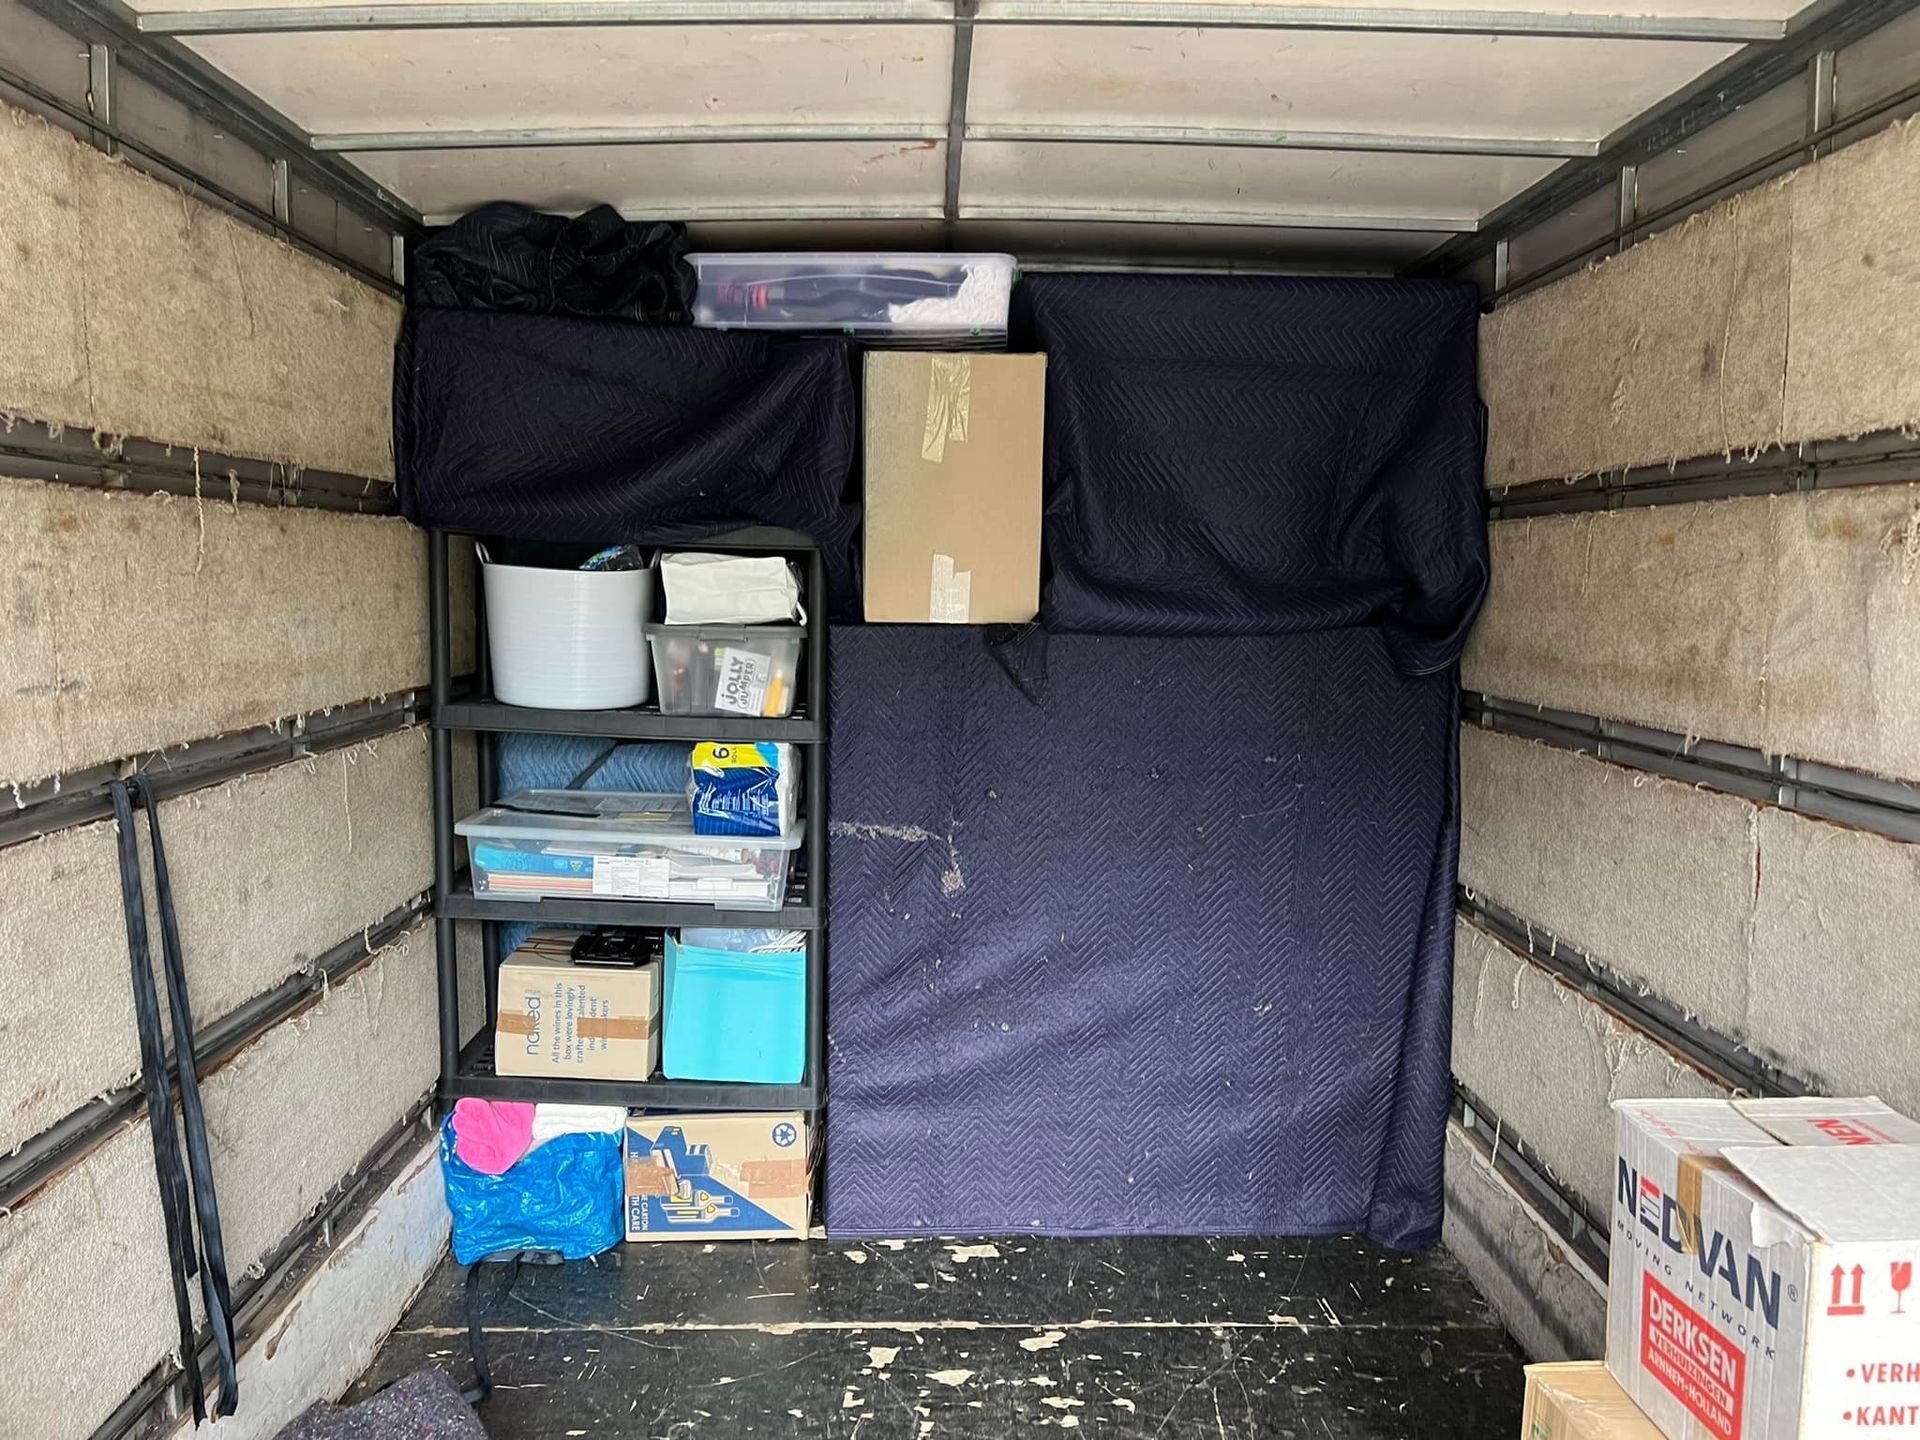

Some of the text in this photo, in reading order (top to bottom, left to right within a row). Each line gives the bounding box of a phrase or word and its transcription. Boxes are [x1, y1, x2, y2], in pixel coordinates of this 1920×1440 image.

[713, 747, 729, 759] 6
[552, 983, 563, 1063] All the wines in this
[565, 986, 576, 1020] lovingly
[575, 985, 586, 1063] crafte alented
[563, 1044, 572, 1060] box
[631, 1208, 640, 1231] CARE
[1618, 1155, 1781, 1330] NEDVAN
[1617, 1220, 1775, 1360] MOVING NETWORK
[1649, 1287, 1737, 1392] DERKSEN
[1653, 1331, 1728, 1407] VERHUIZINGEN
[1861, 1363, 1920, 1383] VERH
[1856, 1405, 1919, 1426] KANT
